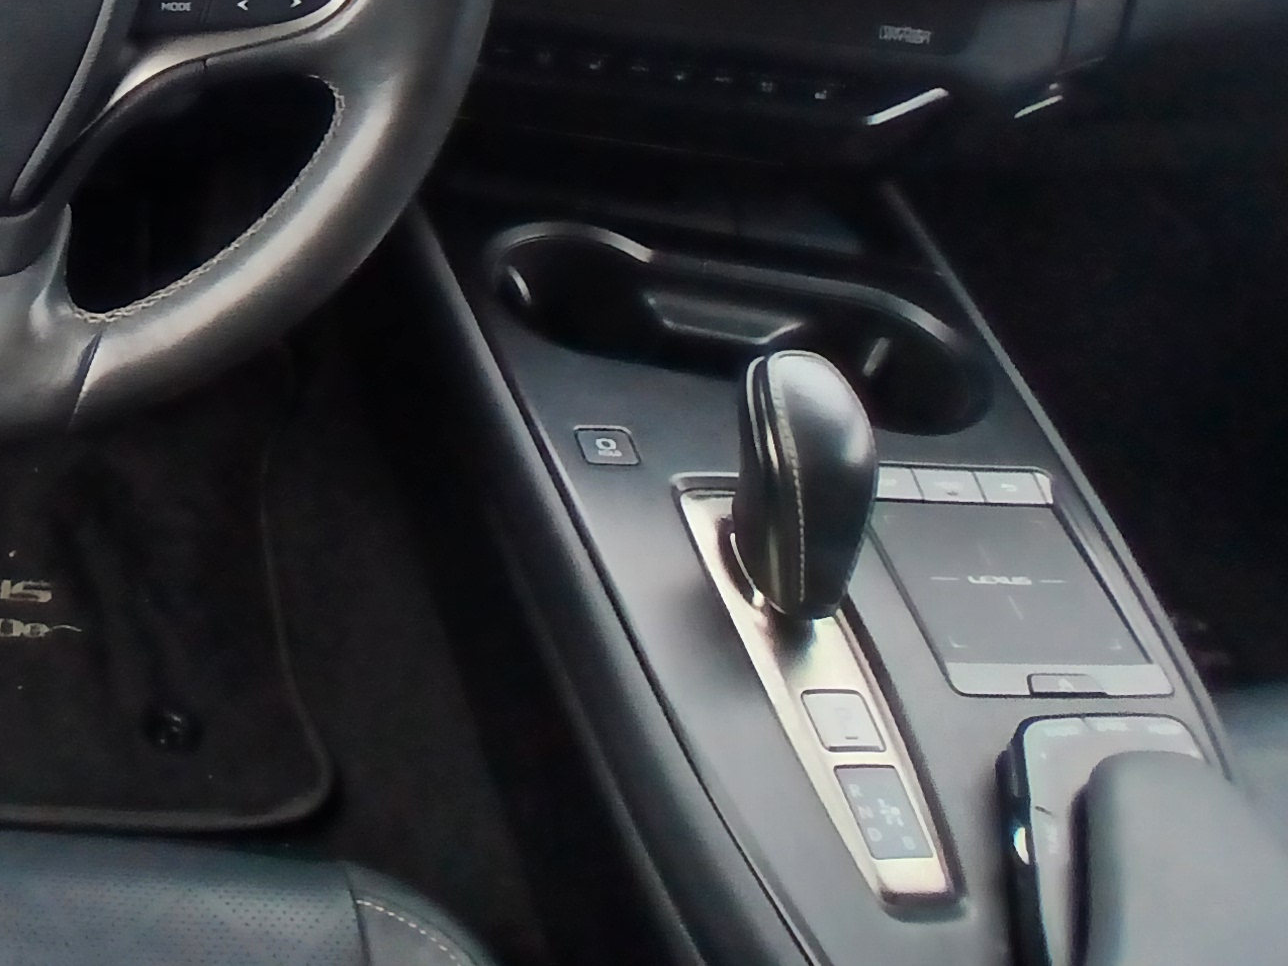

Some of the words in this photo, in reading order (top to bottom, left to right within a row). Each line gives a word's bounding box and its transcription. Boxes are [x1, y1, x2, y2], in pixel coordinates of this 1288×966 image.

[161, 1, 192, 12] MODE
[848, 783, 863, 798] R
[857, 805, 875, 820] N
[867, 827, 883, 843] D
